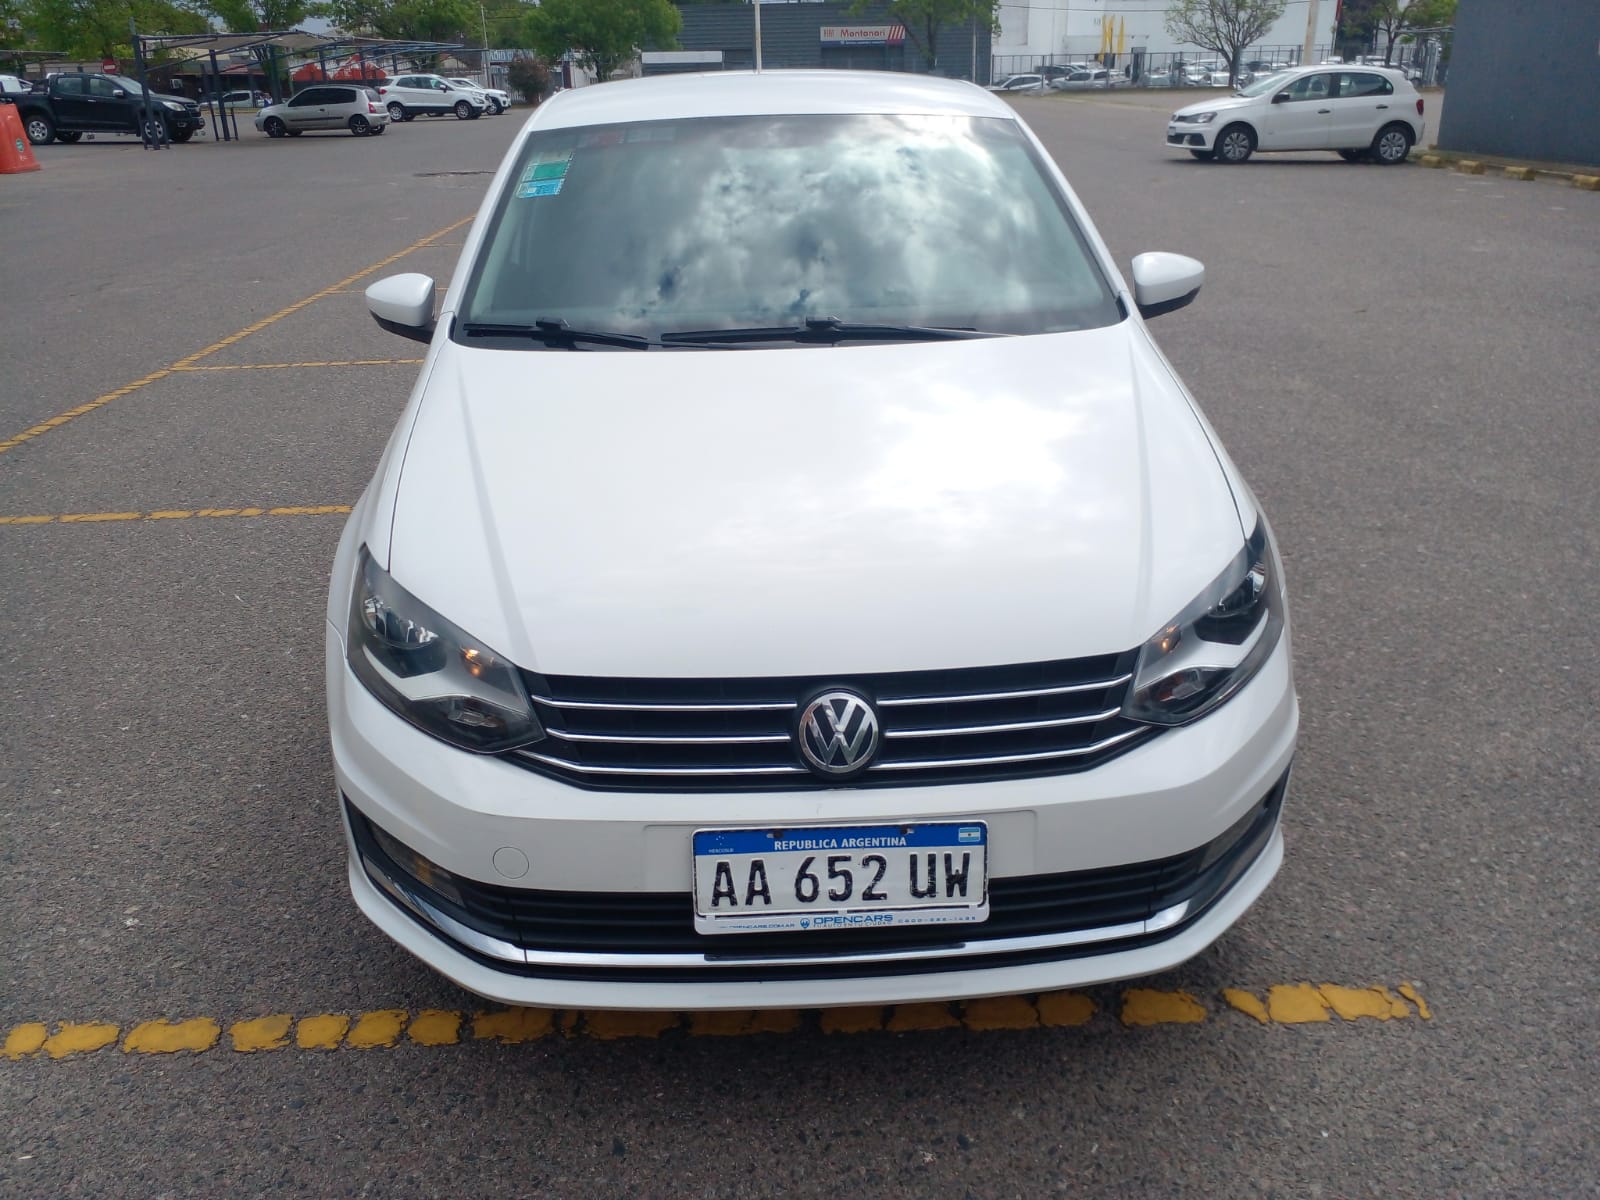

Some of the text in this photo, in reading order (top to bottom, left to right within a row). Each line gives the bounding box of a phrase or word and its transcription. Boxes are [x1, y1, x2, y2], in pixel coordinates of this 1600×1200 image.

[774, 837, 907, 851] REPUBLICA ARGENTINA
[711, 852, 971, 907] AA 652 UW
[813, 914, 893, 924] OPENCARS
